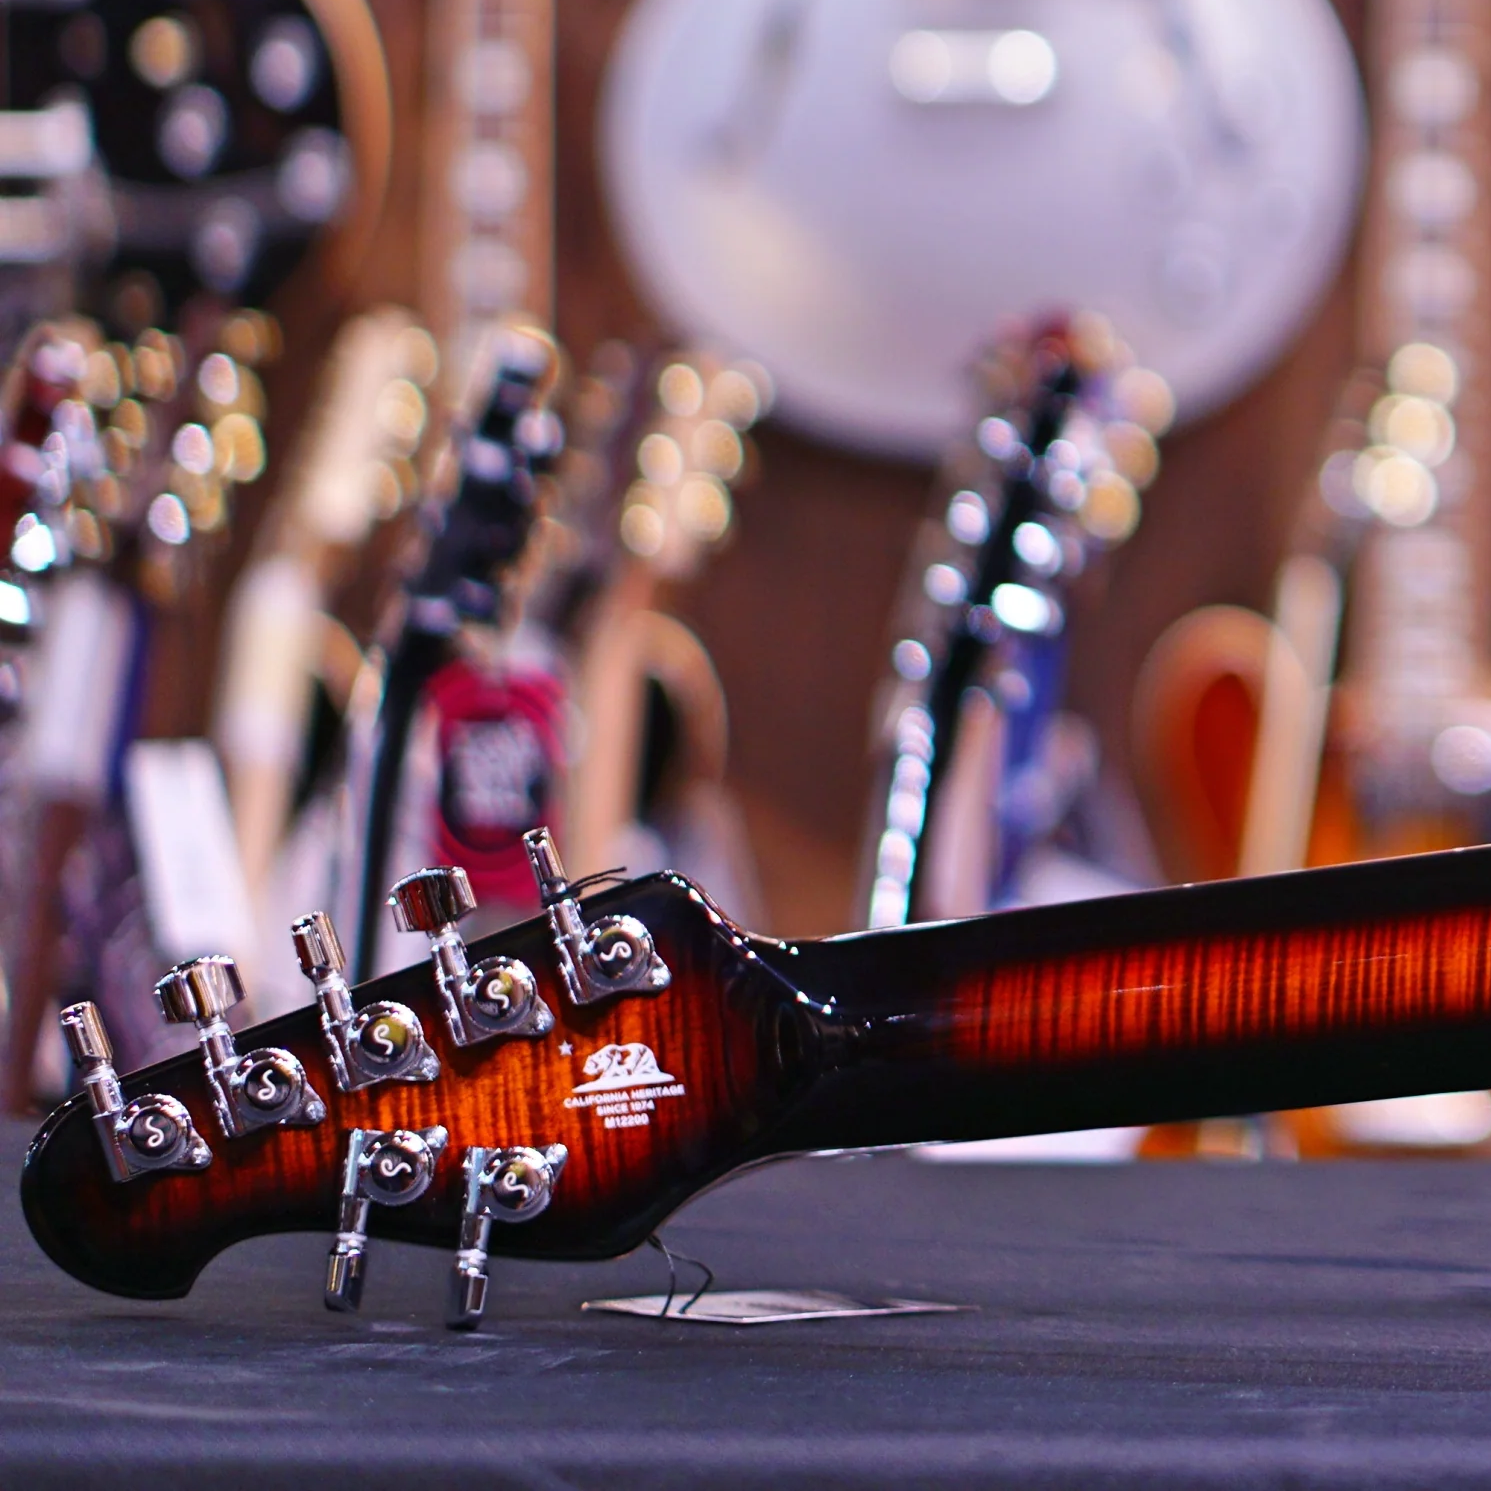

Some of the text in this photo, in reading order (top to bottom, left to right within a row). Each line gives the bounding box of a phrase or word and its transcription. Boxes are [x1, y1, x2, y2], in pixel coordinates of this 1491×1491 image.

[563, 1084, 686, 1108] CALIFORNIA HERITAGE
[596, 1099, 655, 1116] SINCE 1974
